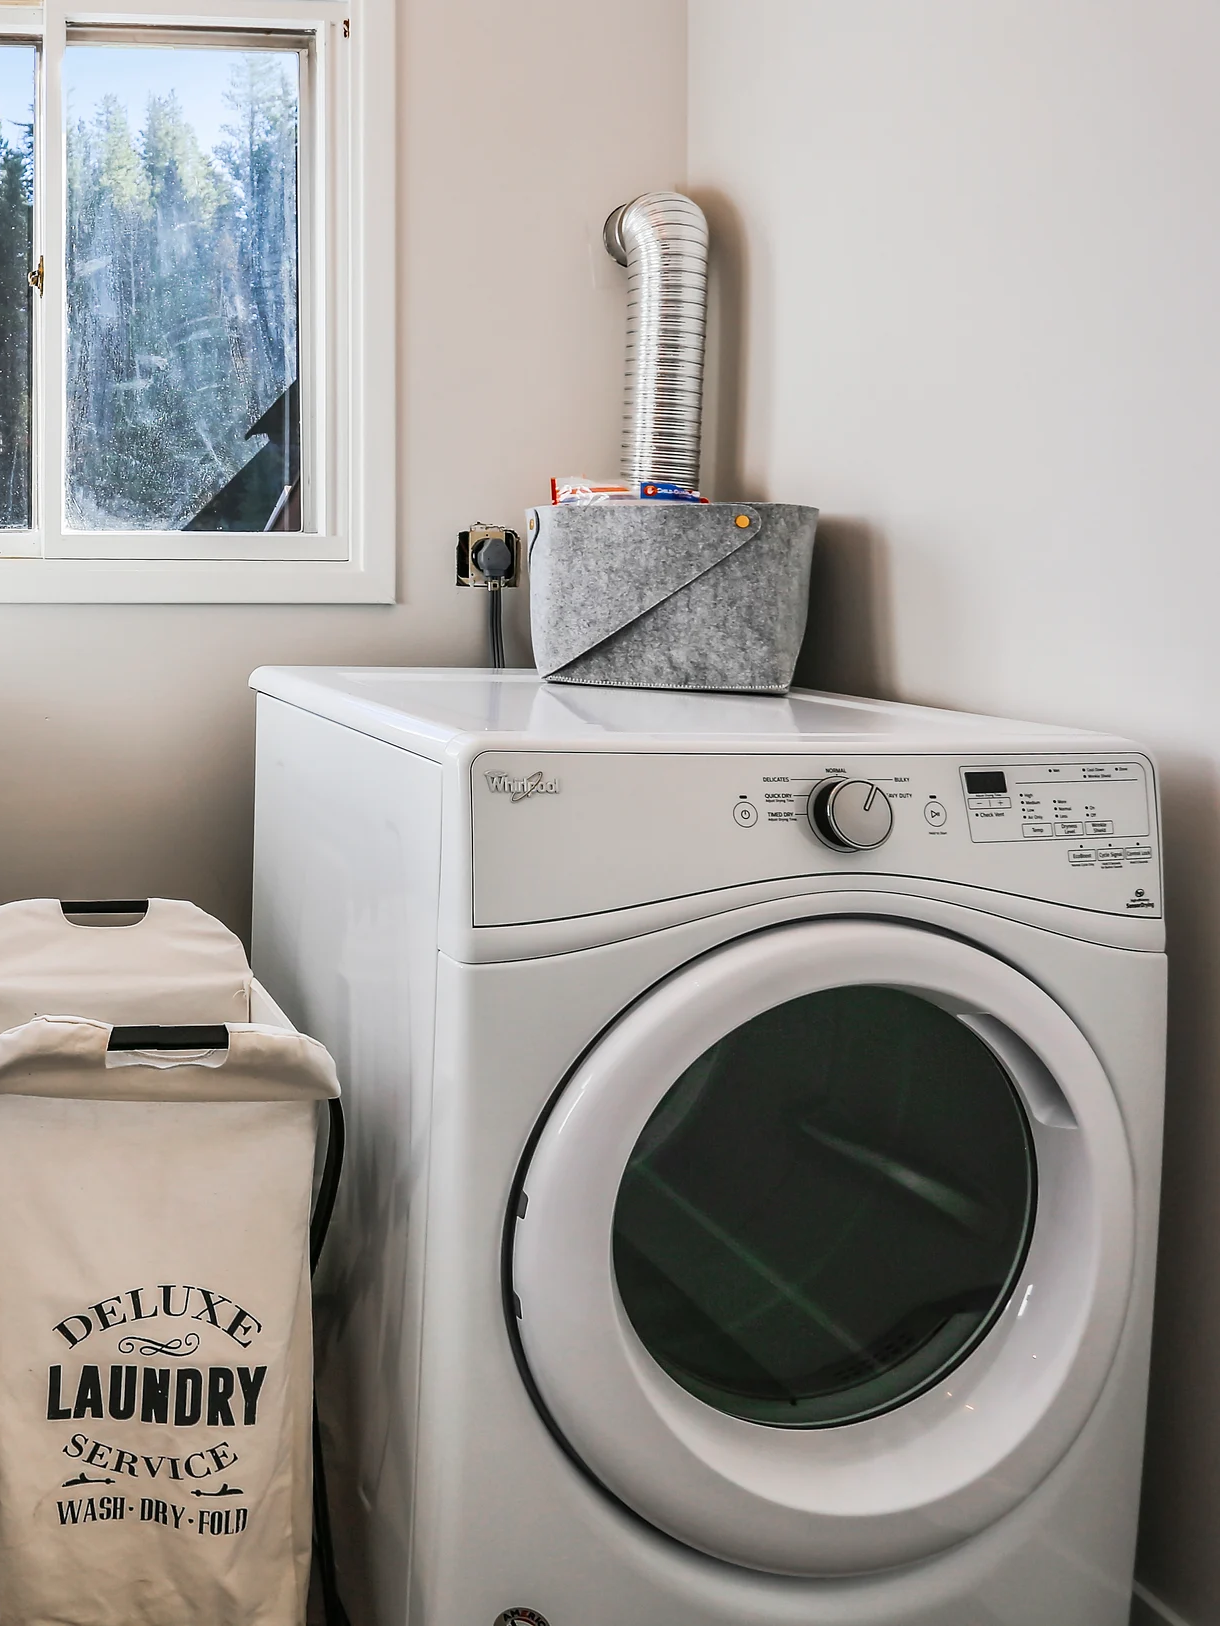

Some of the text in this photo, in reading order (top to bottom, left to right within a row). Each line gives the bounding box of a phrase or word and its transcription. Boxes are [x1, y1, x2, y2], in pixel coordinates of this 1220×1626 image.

[484, 770, 560, 803] Whirlpool
[52, 1284, 263, 1350] DELUXE
[46, 1364, 268, 1427] LAUNDRY
[62, 1433, 239, 1480] SERVICE
[56, 1496, 248, 1536] WASH DRY FOLD
